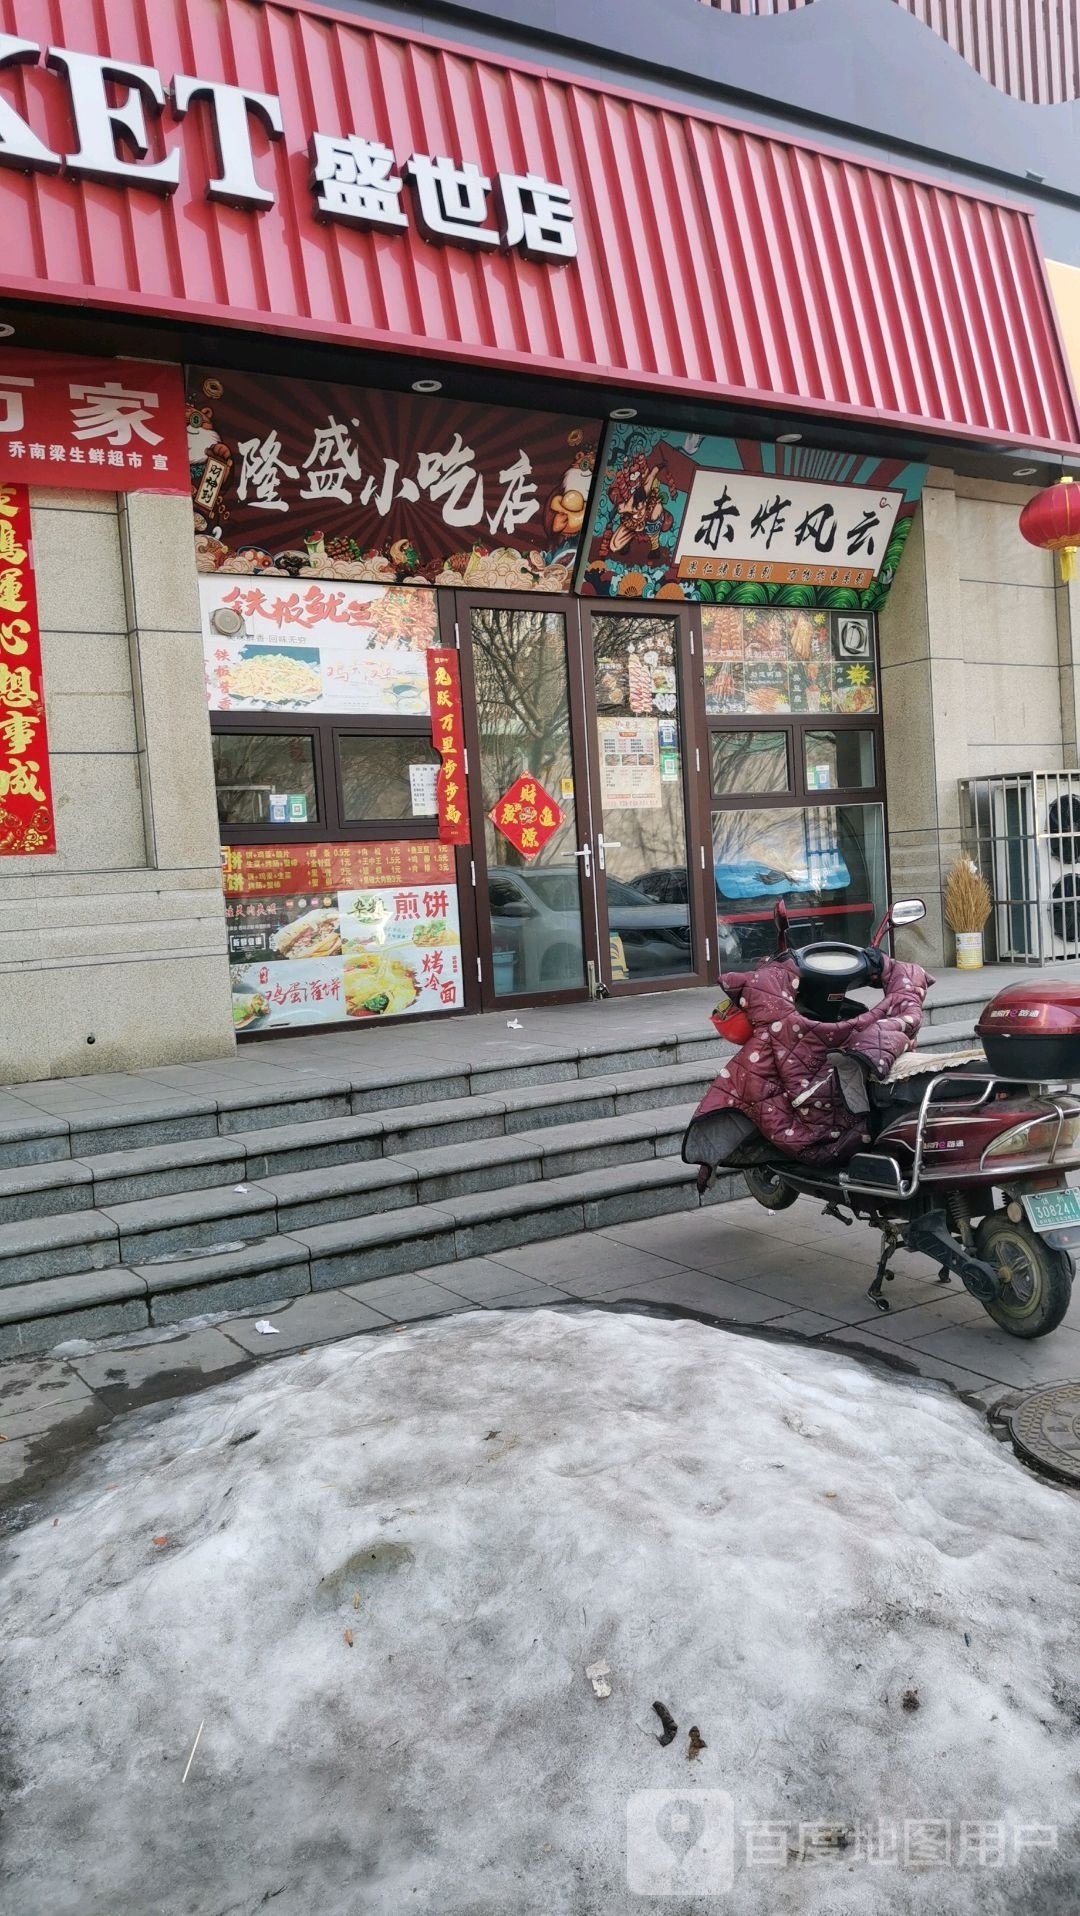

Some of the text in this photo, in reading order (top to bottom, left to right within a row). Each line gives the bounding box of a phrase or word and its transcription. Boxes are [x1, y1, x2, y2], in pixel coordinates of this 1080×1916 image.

[312, 133, 577, 260] 盛世店
[8, 441, 169, 471] 乔南梁生鲜超市 宣
[236, 415, 542, 535] 隆盛小吃店
[694, 485, 881, 556] 赤炸风云
[434, 666, 462, 824] 兔跃万里步步高
[393, 890, 449, 921] 煎饼
[264, 976, 341, 1006] 鸡蛋灌饼
[422, 950, 457, 1004] 烤冷面
[1035, 1201, 1077, 1219] 308241
